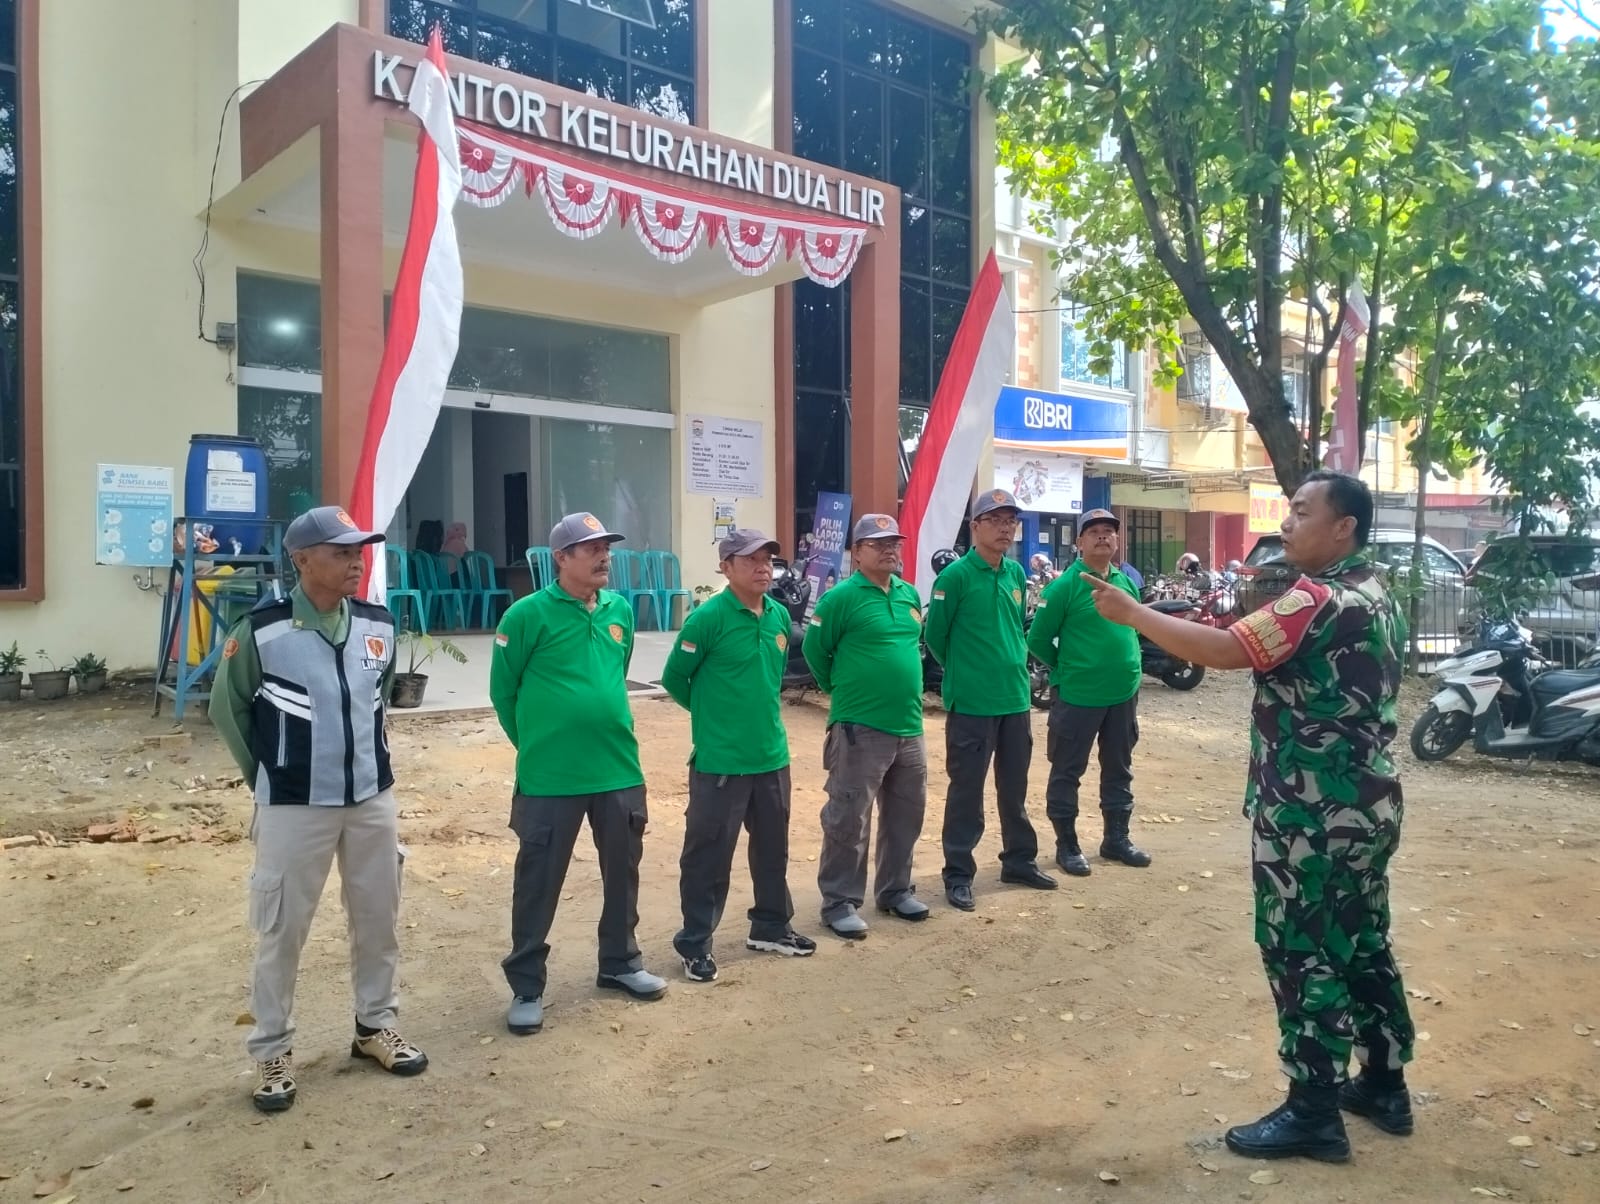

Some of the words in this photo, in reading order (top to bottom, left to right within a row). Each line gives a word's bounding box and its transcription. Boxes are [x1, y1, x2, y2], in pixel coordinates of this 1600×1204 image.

[374, 50, 548, 138] KNTOR
[561, 101, 765, 194] KELURAHAN
[772, 162, 831, 212] DUA
[838, 180, 885, 226] ILIR
[1044, 402, 1072, 430] BRI
[820, 518, 842, 530] PILIH
[815, 528, 844, 542] LAPOR
[814, 538, 842, 553] PAJAK
